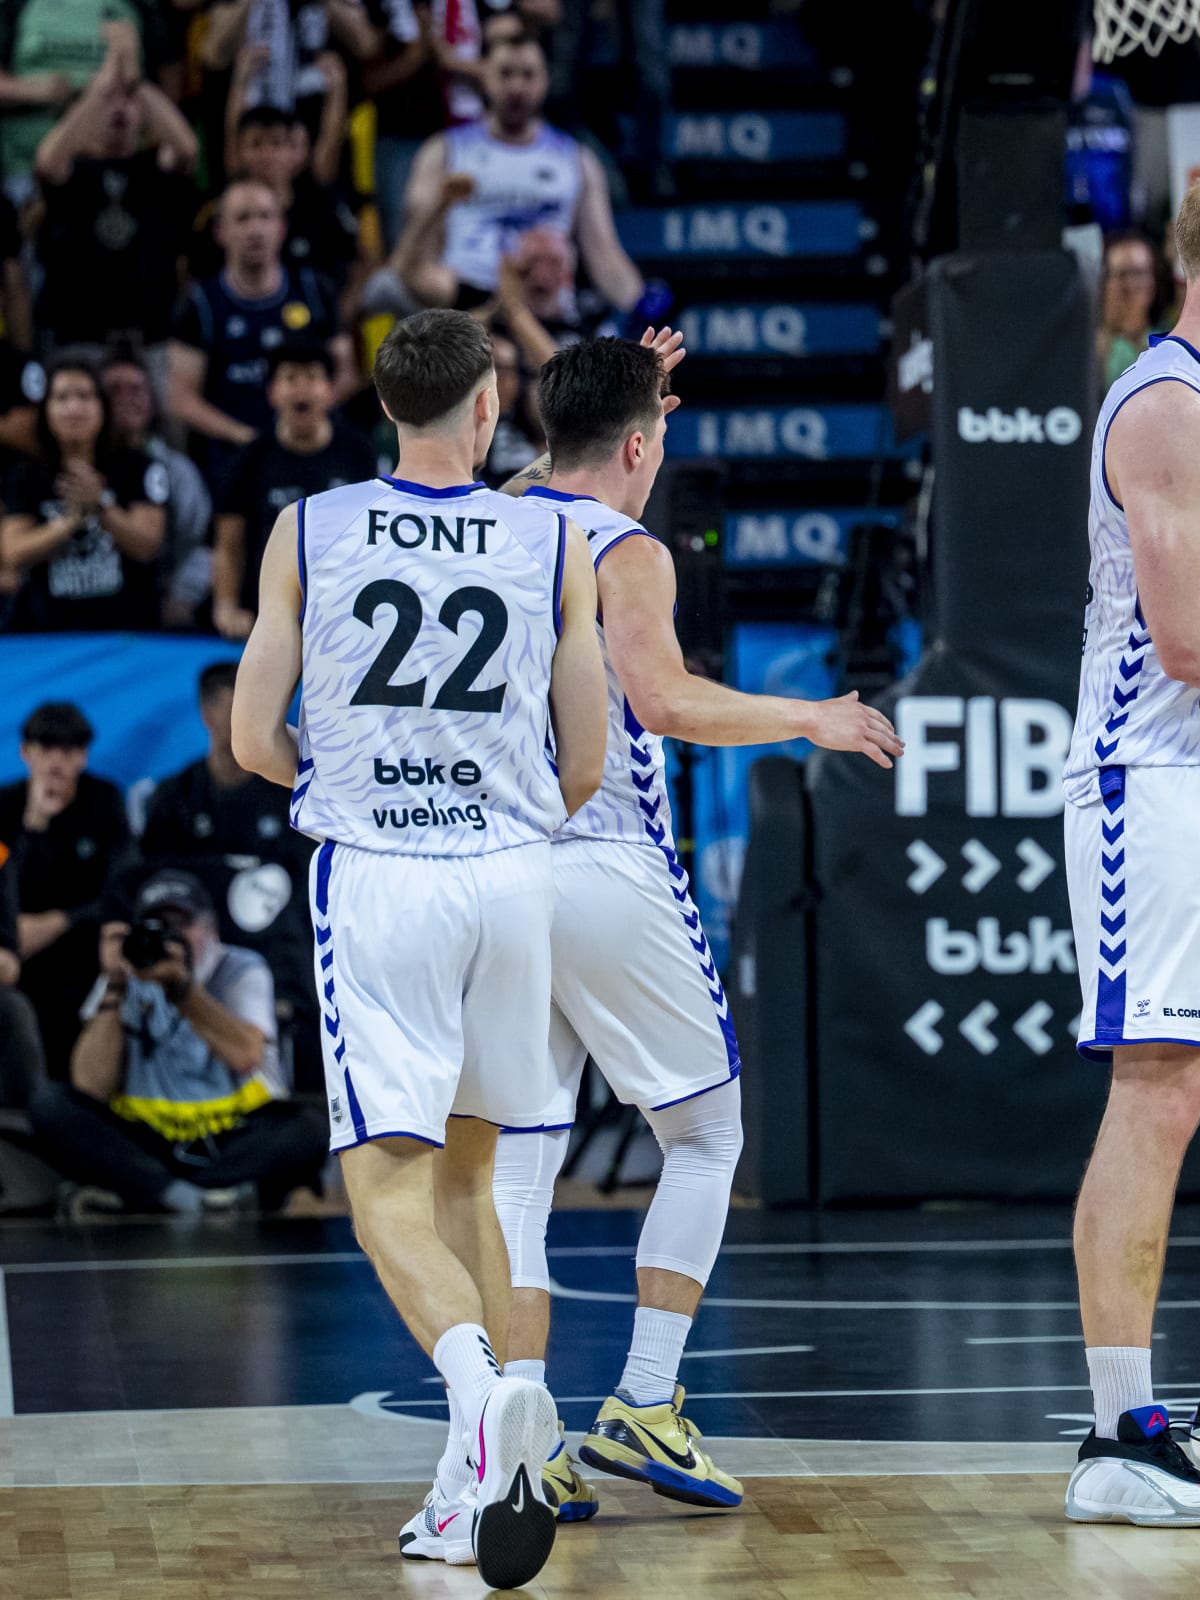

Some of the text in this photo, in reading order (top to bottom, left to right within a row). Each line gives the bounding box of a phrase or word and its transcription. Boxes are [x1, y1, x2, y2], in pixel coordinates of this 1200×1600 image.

[663, 204, 789, 256] IMQ
[680, 305, 807, 356] IMQ
[697, 408, 828, 460] IMQ
[958, 406, 1044, 443] bbk
[367, 509, 497, 554] FONT
[349, 578, 509, 713] 22
[373, 757, 447, 785] bbk
[895, 695, 1073, 818] FIB
[372, 797, 487, 831] vueling
[926, 916, 1078, 975] bbk
[1163, 1007, 1177, 1017] EL
